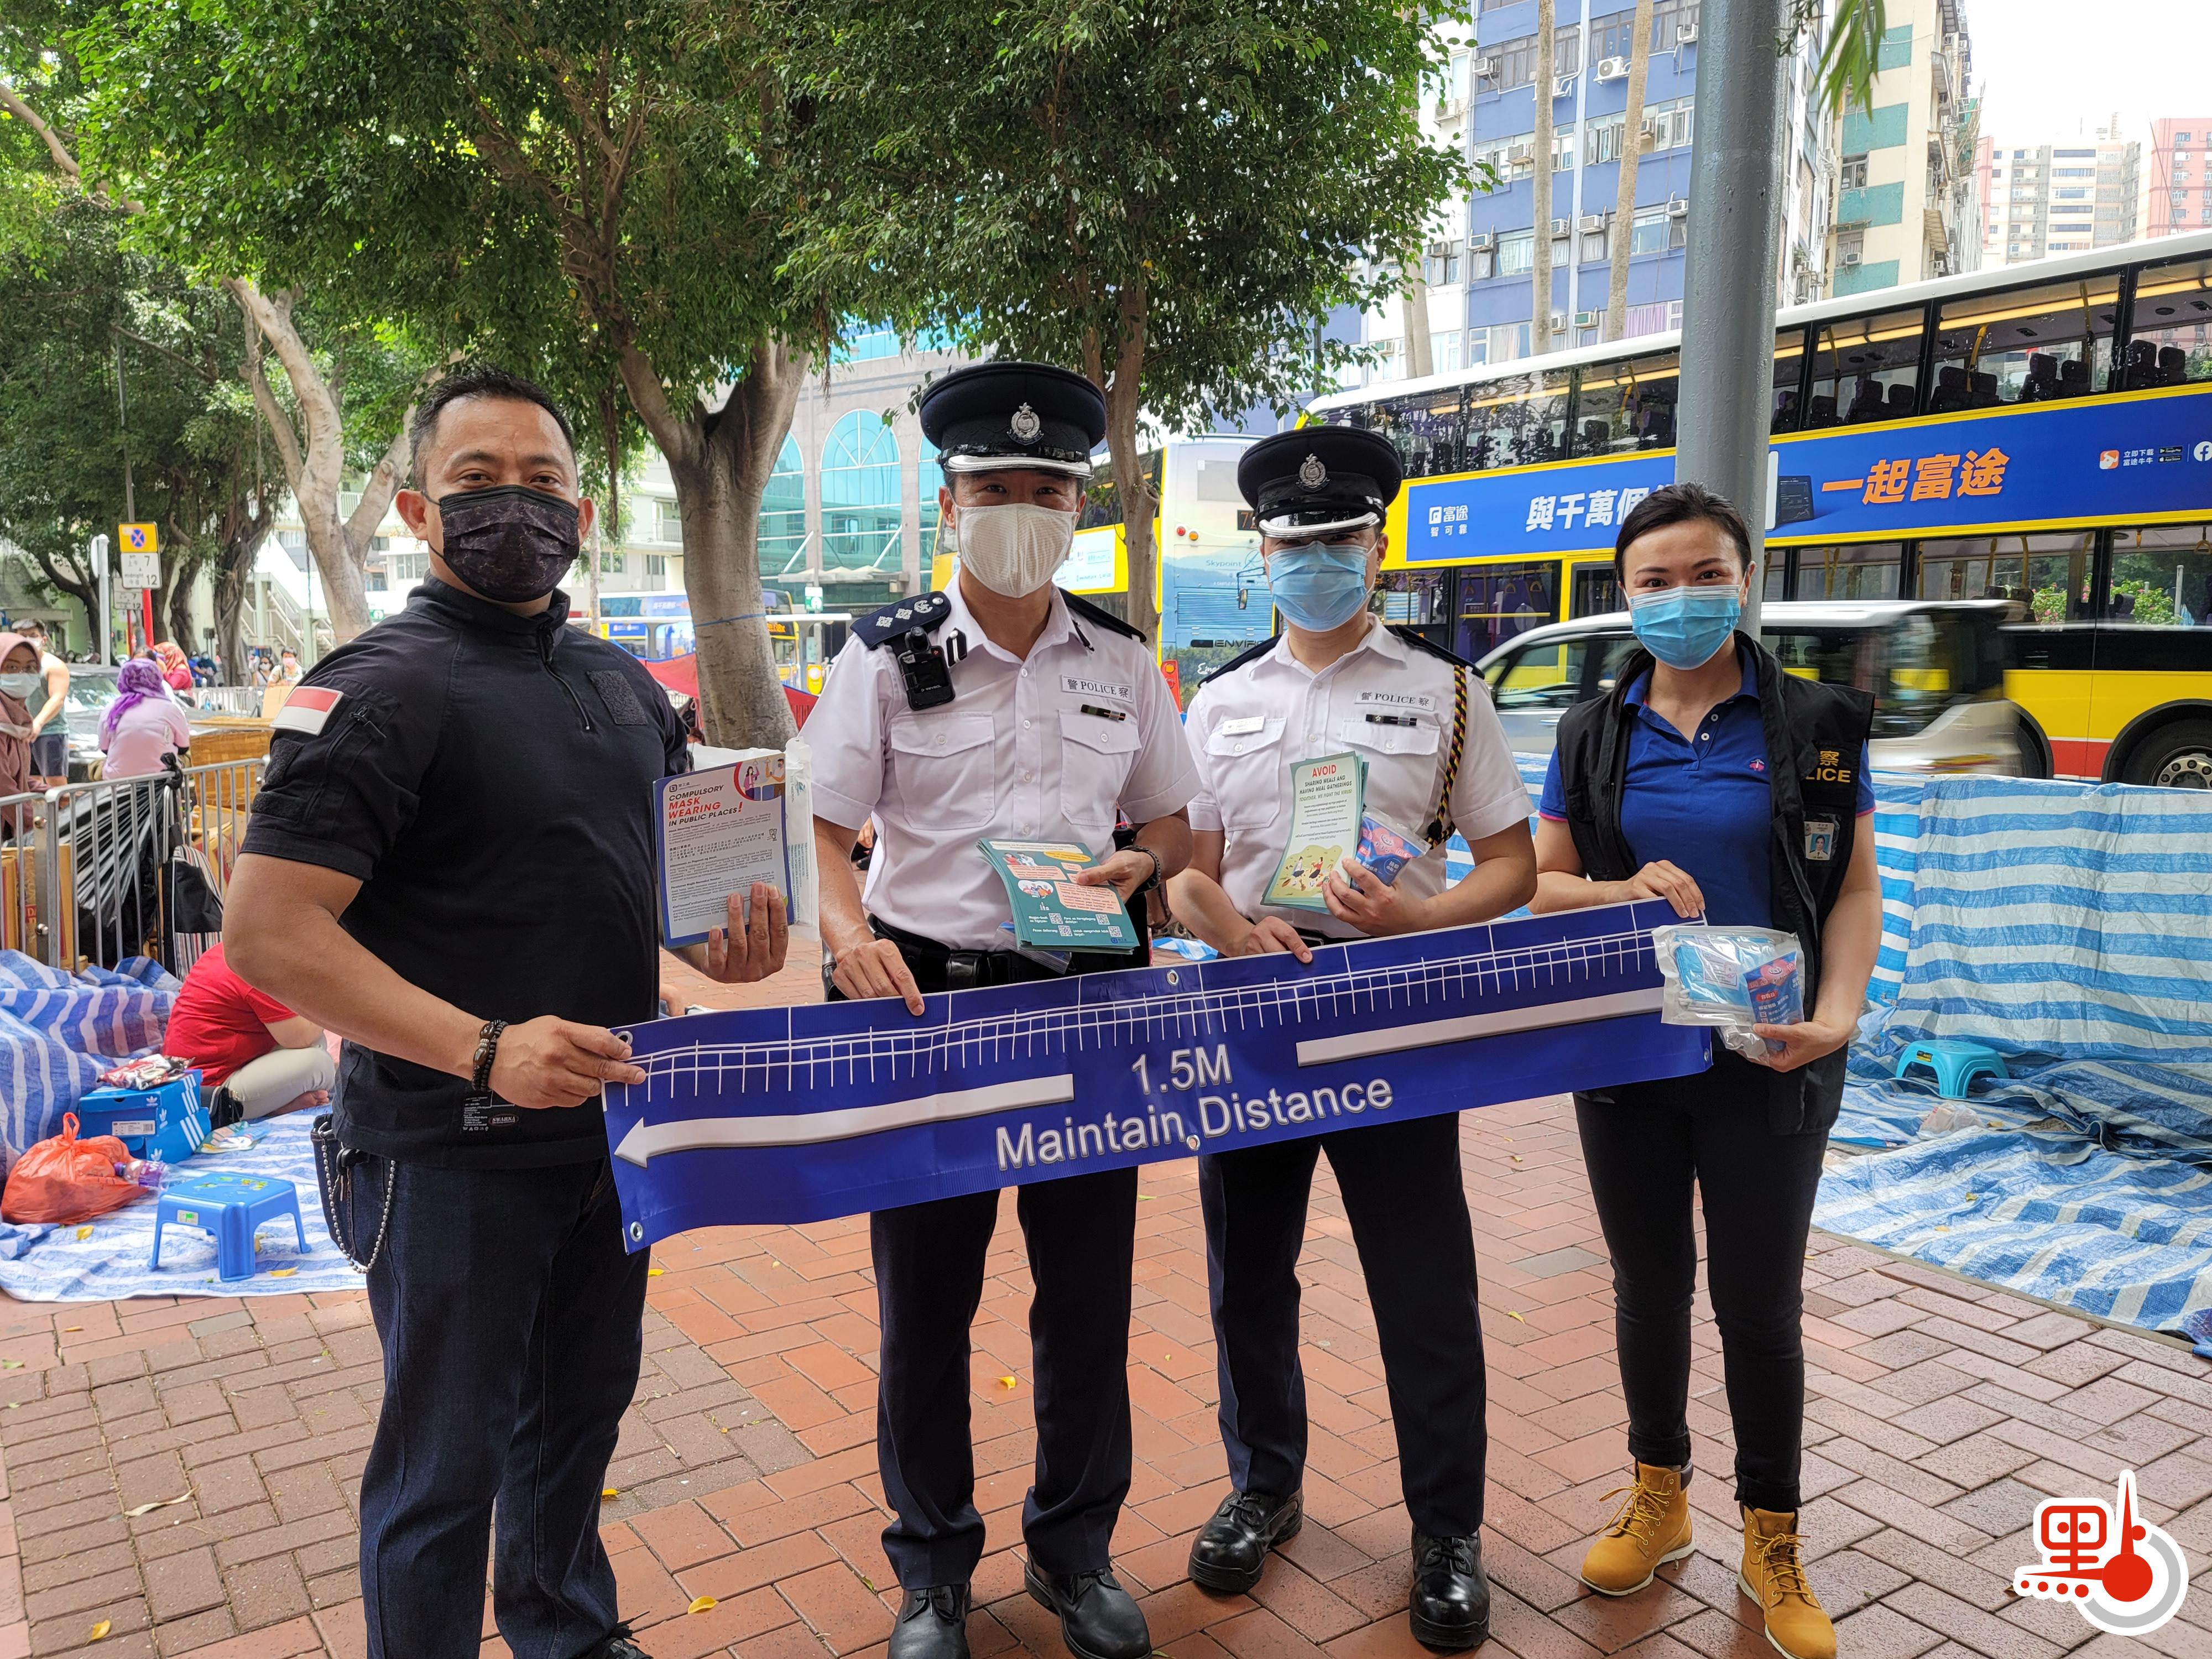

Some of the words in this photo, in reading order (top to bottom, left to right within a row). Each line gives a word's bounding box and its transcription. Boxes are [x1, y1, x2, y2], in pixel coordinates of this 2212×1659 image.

[2123, 448, 2154, 458] 立即下載
[2122, 457, 2154, 467] 富途牛牛
[1525, 483, 1675, 533] 與千萬個
[1821, 447, 2010, 505] 一起富途
[1443, 504, 1469, 523] 富途
[144, 555, 150, 567] 7
[146, 574, 158, 586] 12
[1067, 679, 1078, 691] 警
[1081, 680, 1117, 695] POLICE
[1118, 687, 1129, 698] 察
[1361, 691, 1372, 701] 警
[1374, 692, 1416, 705] POLICE
[1417, 697, 1430, 707] 察
[1819, 750, 1840, 767] 察
[1312, 764, 1337, 778] AVOID
[669, 784, 724, 801] COMPULSORY
[1327, 780, 1353, 790] GATHERINGS
[668, 801, 721, 820] WEARING
[669, 796, 701, 811] MASK
[679, 813, 707, 825] PUBLIC
[1131, 1043, 1233, 1095] 1.5M
[995, 1104, 1186, 1171] Maintain
[1197, 1078, 1394, 1139] Distance
